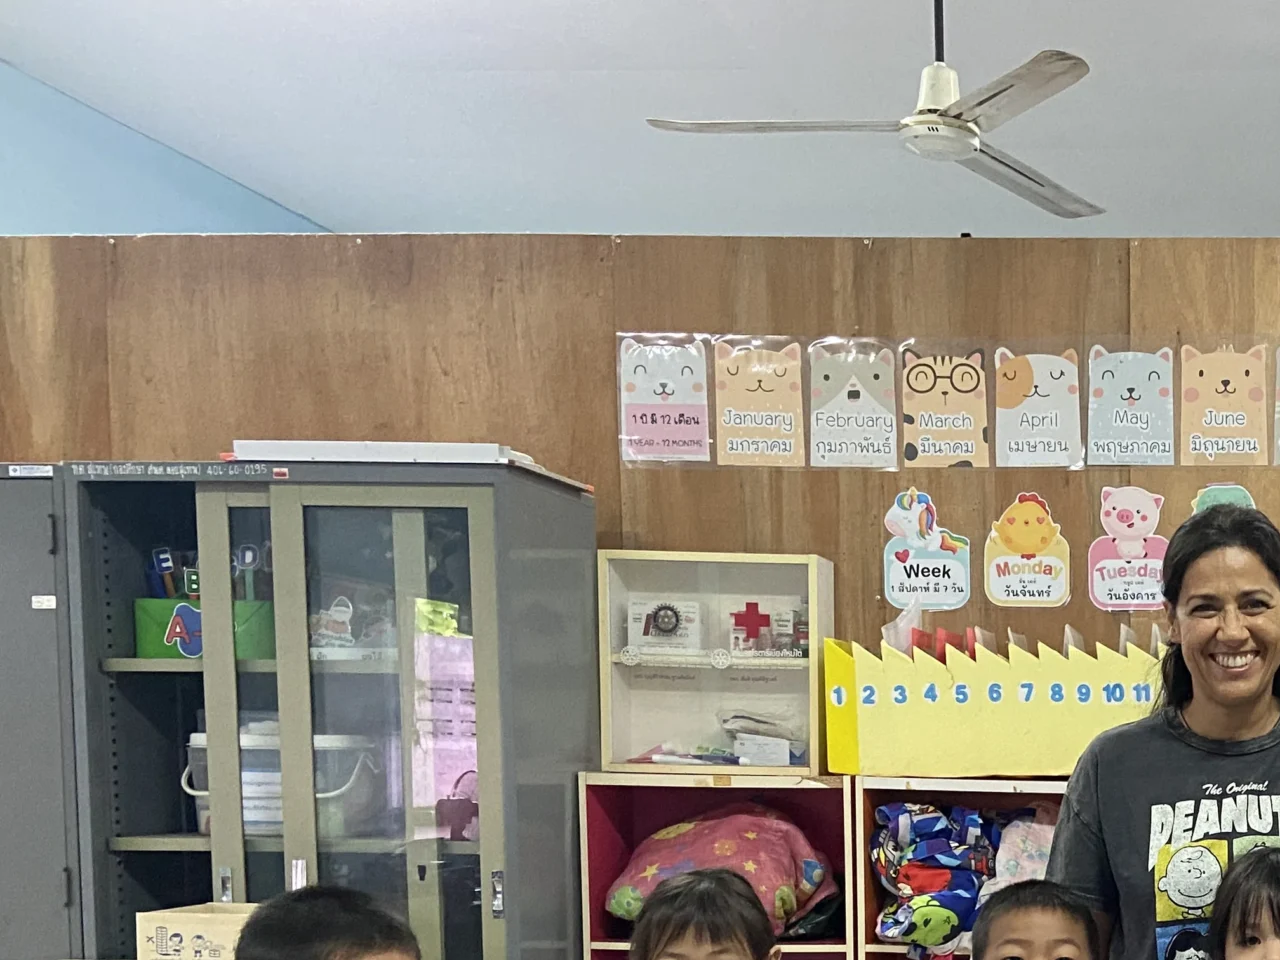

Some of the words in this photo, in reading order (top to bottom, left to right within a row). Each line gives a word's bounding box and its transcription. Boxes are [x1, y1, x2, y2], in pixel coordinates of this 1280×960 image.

[660, 415, 671, 424] 12
[723, 410, 793, 432] January
[816, 412, 893, 433] February
[919, 413, 972, 429] March
[1019, 412, 1059, 430] April
[1114, 410, 1149, 430] May
[1204, 410, 1246, 426] June
[728, 439, 792, 454] มกราคม
[816, 437, 892, 462] กุมภาพันธ์
[920, 437, 974, 455] มีนาคม
[1008, 440, 1069, 453] เมษายน
[1093, 440, 1171, 458] พฤษภาคม
[1191, 434, 1258, 460] มิถุนายน
[903, 563, 951, 579] Week
[995, 560, 1063, 580] Monday
[952, 583, 964, 593] วัน
[1004, 585, 1052, 598] วันจันทร์
[1107, 588, 1157, 600] วันอังคาร
[832, 687, 843, 705] 1
[862, 685, 876, 705] 2
[893, 685, 908, 704] 3
[923, 683, 938, 703] 4
[955, 684, 969, 704] 5
[988, 683, 1002, 701] 6
[1020, 683, 1034, 702] 7
[1050, 683, 1064, 702] 8
[1077, 683, 1091, 703] 9
[1102, 683, 1125, 702] 10
[1132, 683, 1151, 702] 11
[1202, 783, 1223, 796] The
[1226, 780, 1269, 794] Original
